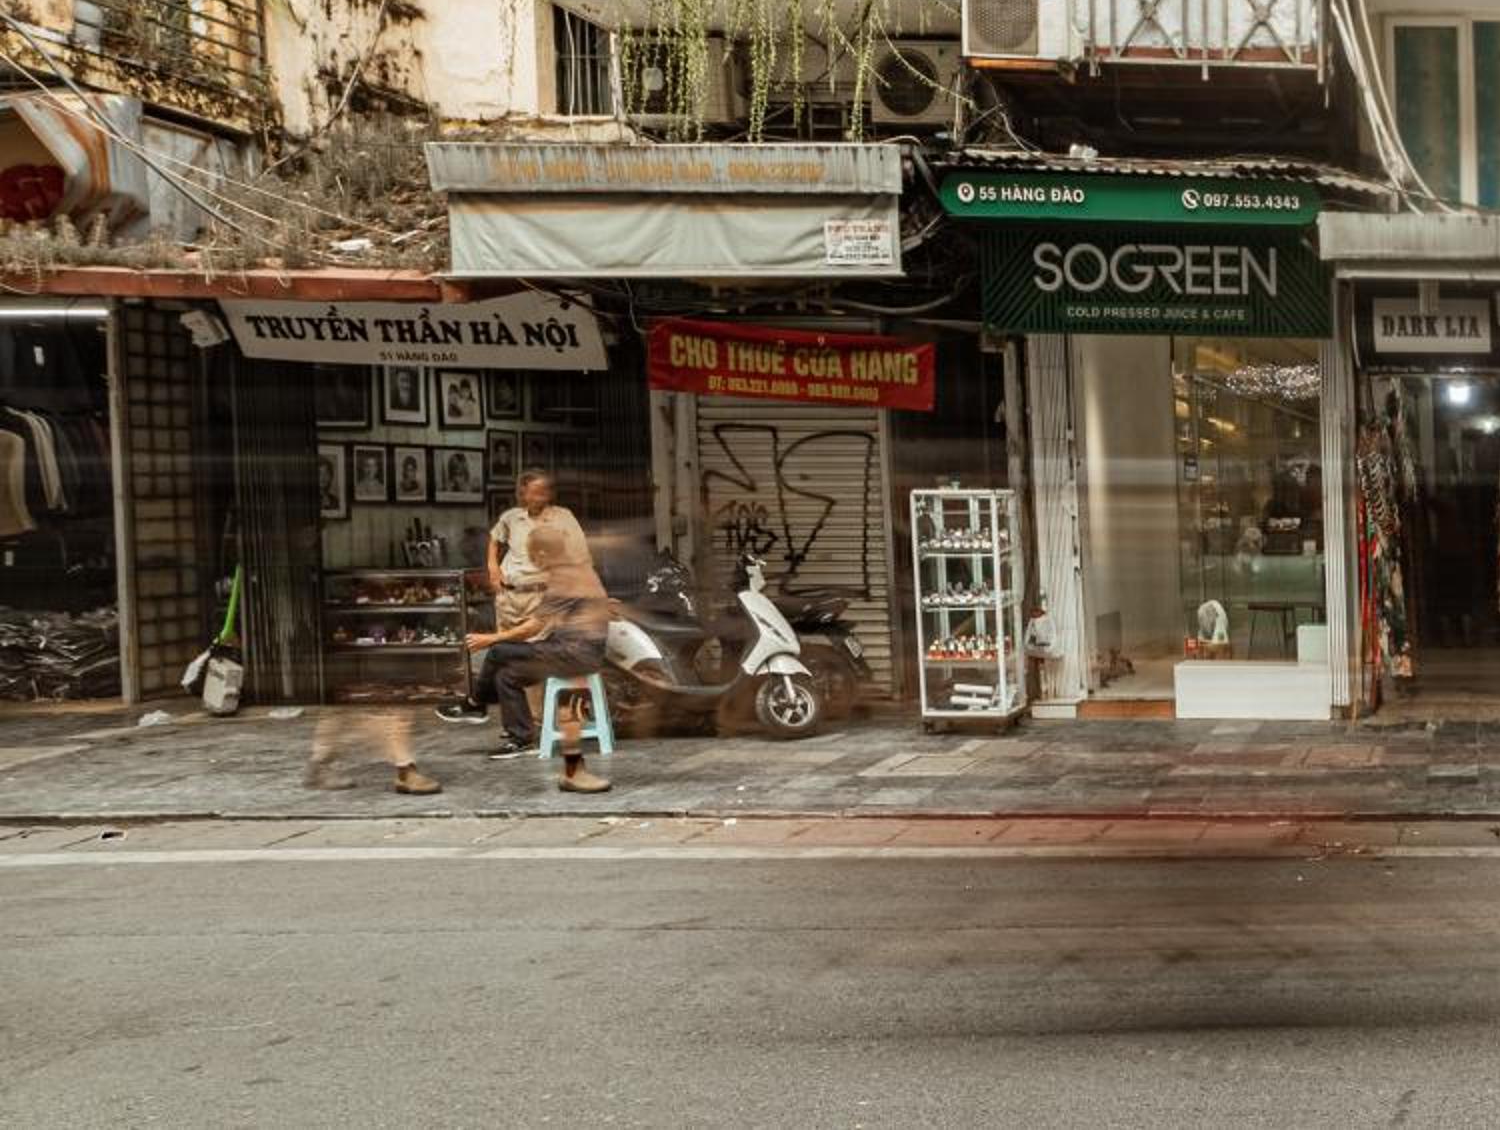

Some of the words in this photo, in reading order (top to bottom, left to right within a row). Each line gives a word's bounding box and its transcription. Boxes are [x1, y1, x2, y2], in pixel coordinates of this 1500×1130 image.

[978, 187, 998, 201] 55
[1001, 183, 1046, 202] HÀNG
[1051, 183, 1085, 203] ĐÀO
[1203, 192, 1301, 211] 097.553.4343
[1033, 242, 1278, 297] SOGREEN
[1067, 306, 1100, 319] COLD
[1103, 306, 1160, 320] PRESSED
[1163, 307, 1199, 320] JUICE
[245, 305, 369, 343] TRUYỀN
[374, 307, 465, 345] THẦN
[469, 313, 518, 347] HÀ
[522, 316, 580, 352] NỘI
[1445, 315, 1483, 339] LIA
[669, 334, 718, 369] CHO
